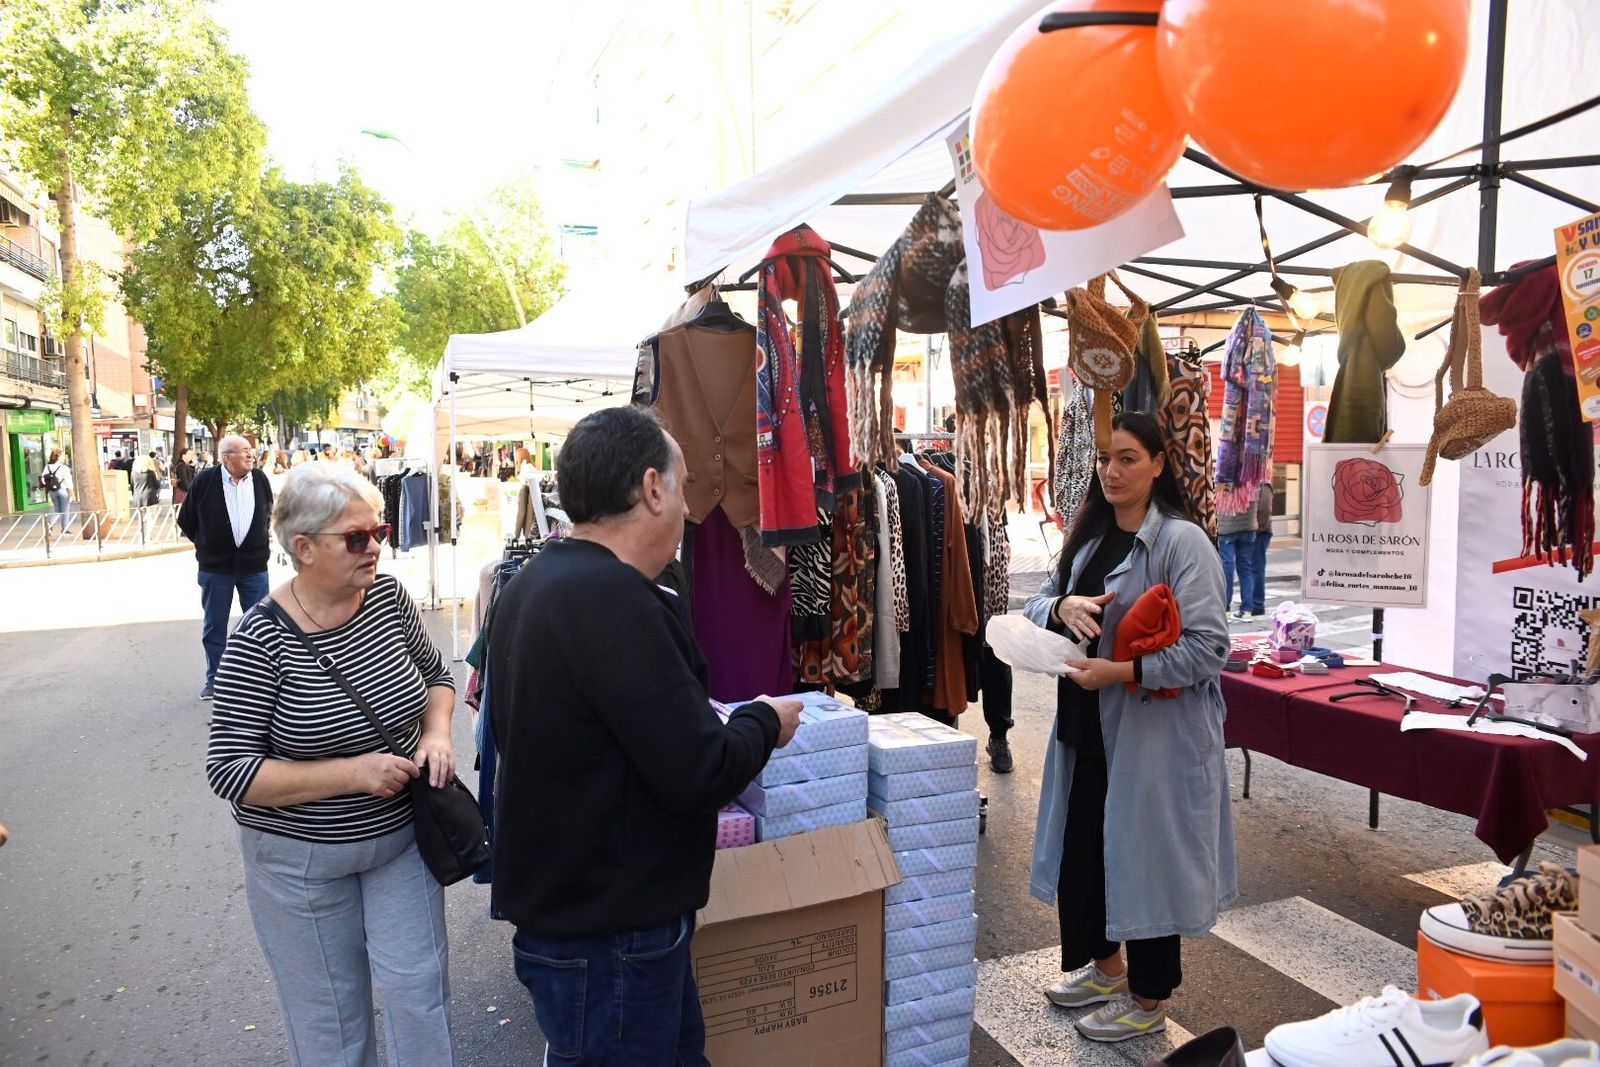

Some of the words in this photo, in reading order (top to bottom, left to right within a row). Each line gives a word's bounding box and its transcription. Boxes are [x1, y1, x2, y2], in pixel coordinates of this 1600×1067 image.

[1584, 267, 1594, 280] 17
[1474, 451, 1492, 468] LA
[1312, 533, 1325, 543] LA
[1328, 533, 1359, 545] ROSA
[1362, 535, 1377, 545] DE
[1380, 534, 1420, 546] SARÓN
[778, 964, 815, 977] CONJUNTO
[809, 979, 848, 998] 21356
[785, 1015, 808, 1028] BABY
[753, 1022, 784, 1035] HAPPY
